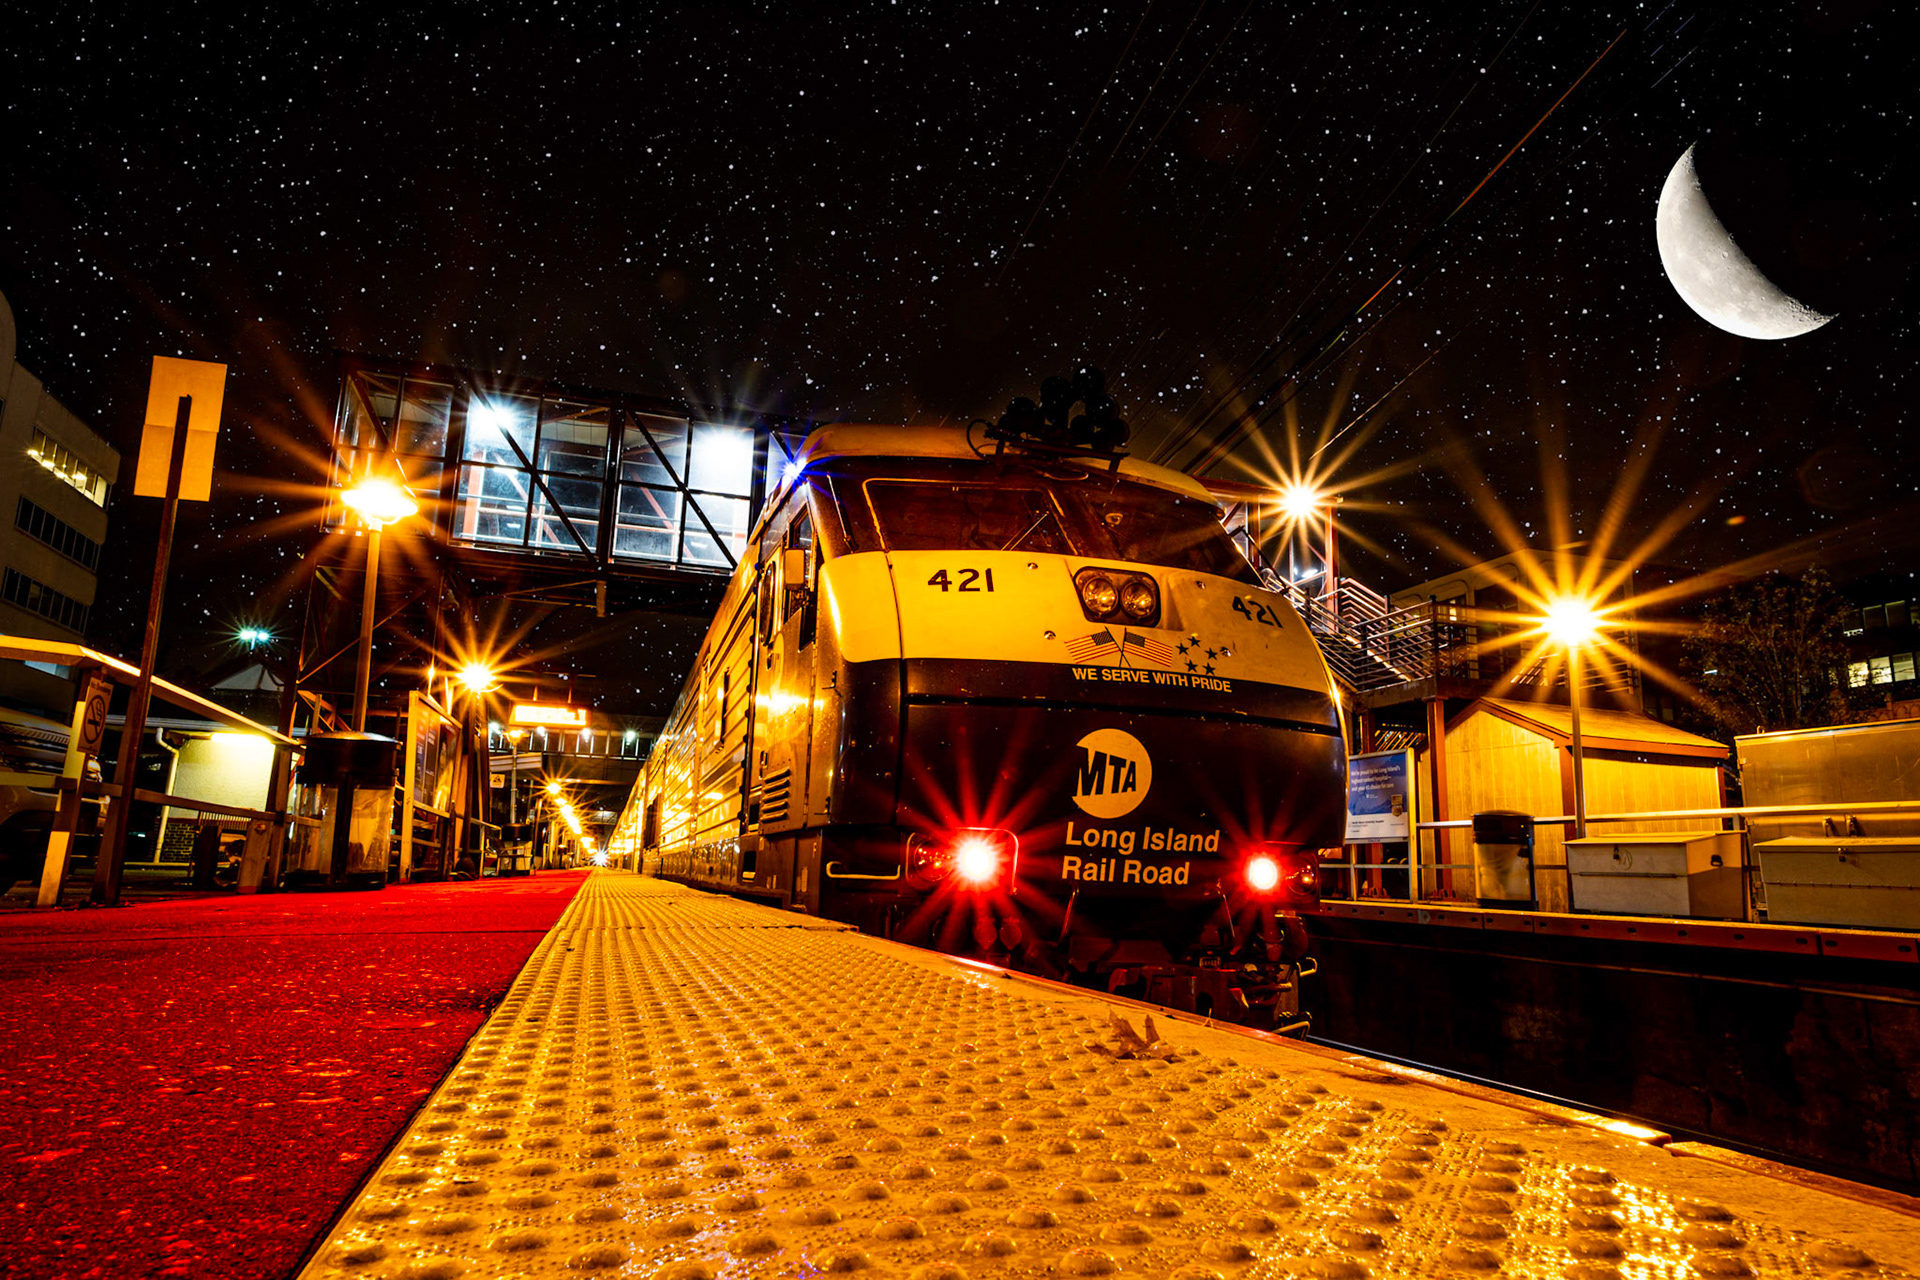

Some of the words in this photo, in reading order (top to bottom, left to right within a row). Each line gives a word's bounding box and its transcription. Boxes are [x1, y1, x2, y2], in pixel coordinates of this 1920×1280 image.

[927, 568, 994, 593] 421
[1231, 596, 1283, 629] 421
[1072, 667, 1098, 681] WE
[1101, 669, 1150, 684] SERVE
[1153, 672, 1189, 688] WITH
[1191, 676, 1232, 693] PRIDE
[1072, 746, 1136, 796] MTA
[1065, 821, 1136, 856] Long
[1142, 826, 1220, 852] Island
[1061, 855, 1116, 882] Rail
[1122, 859, 1190, 885] Road
